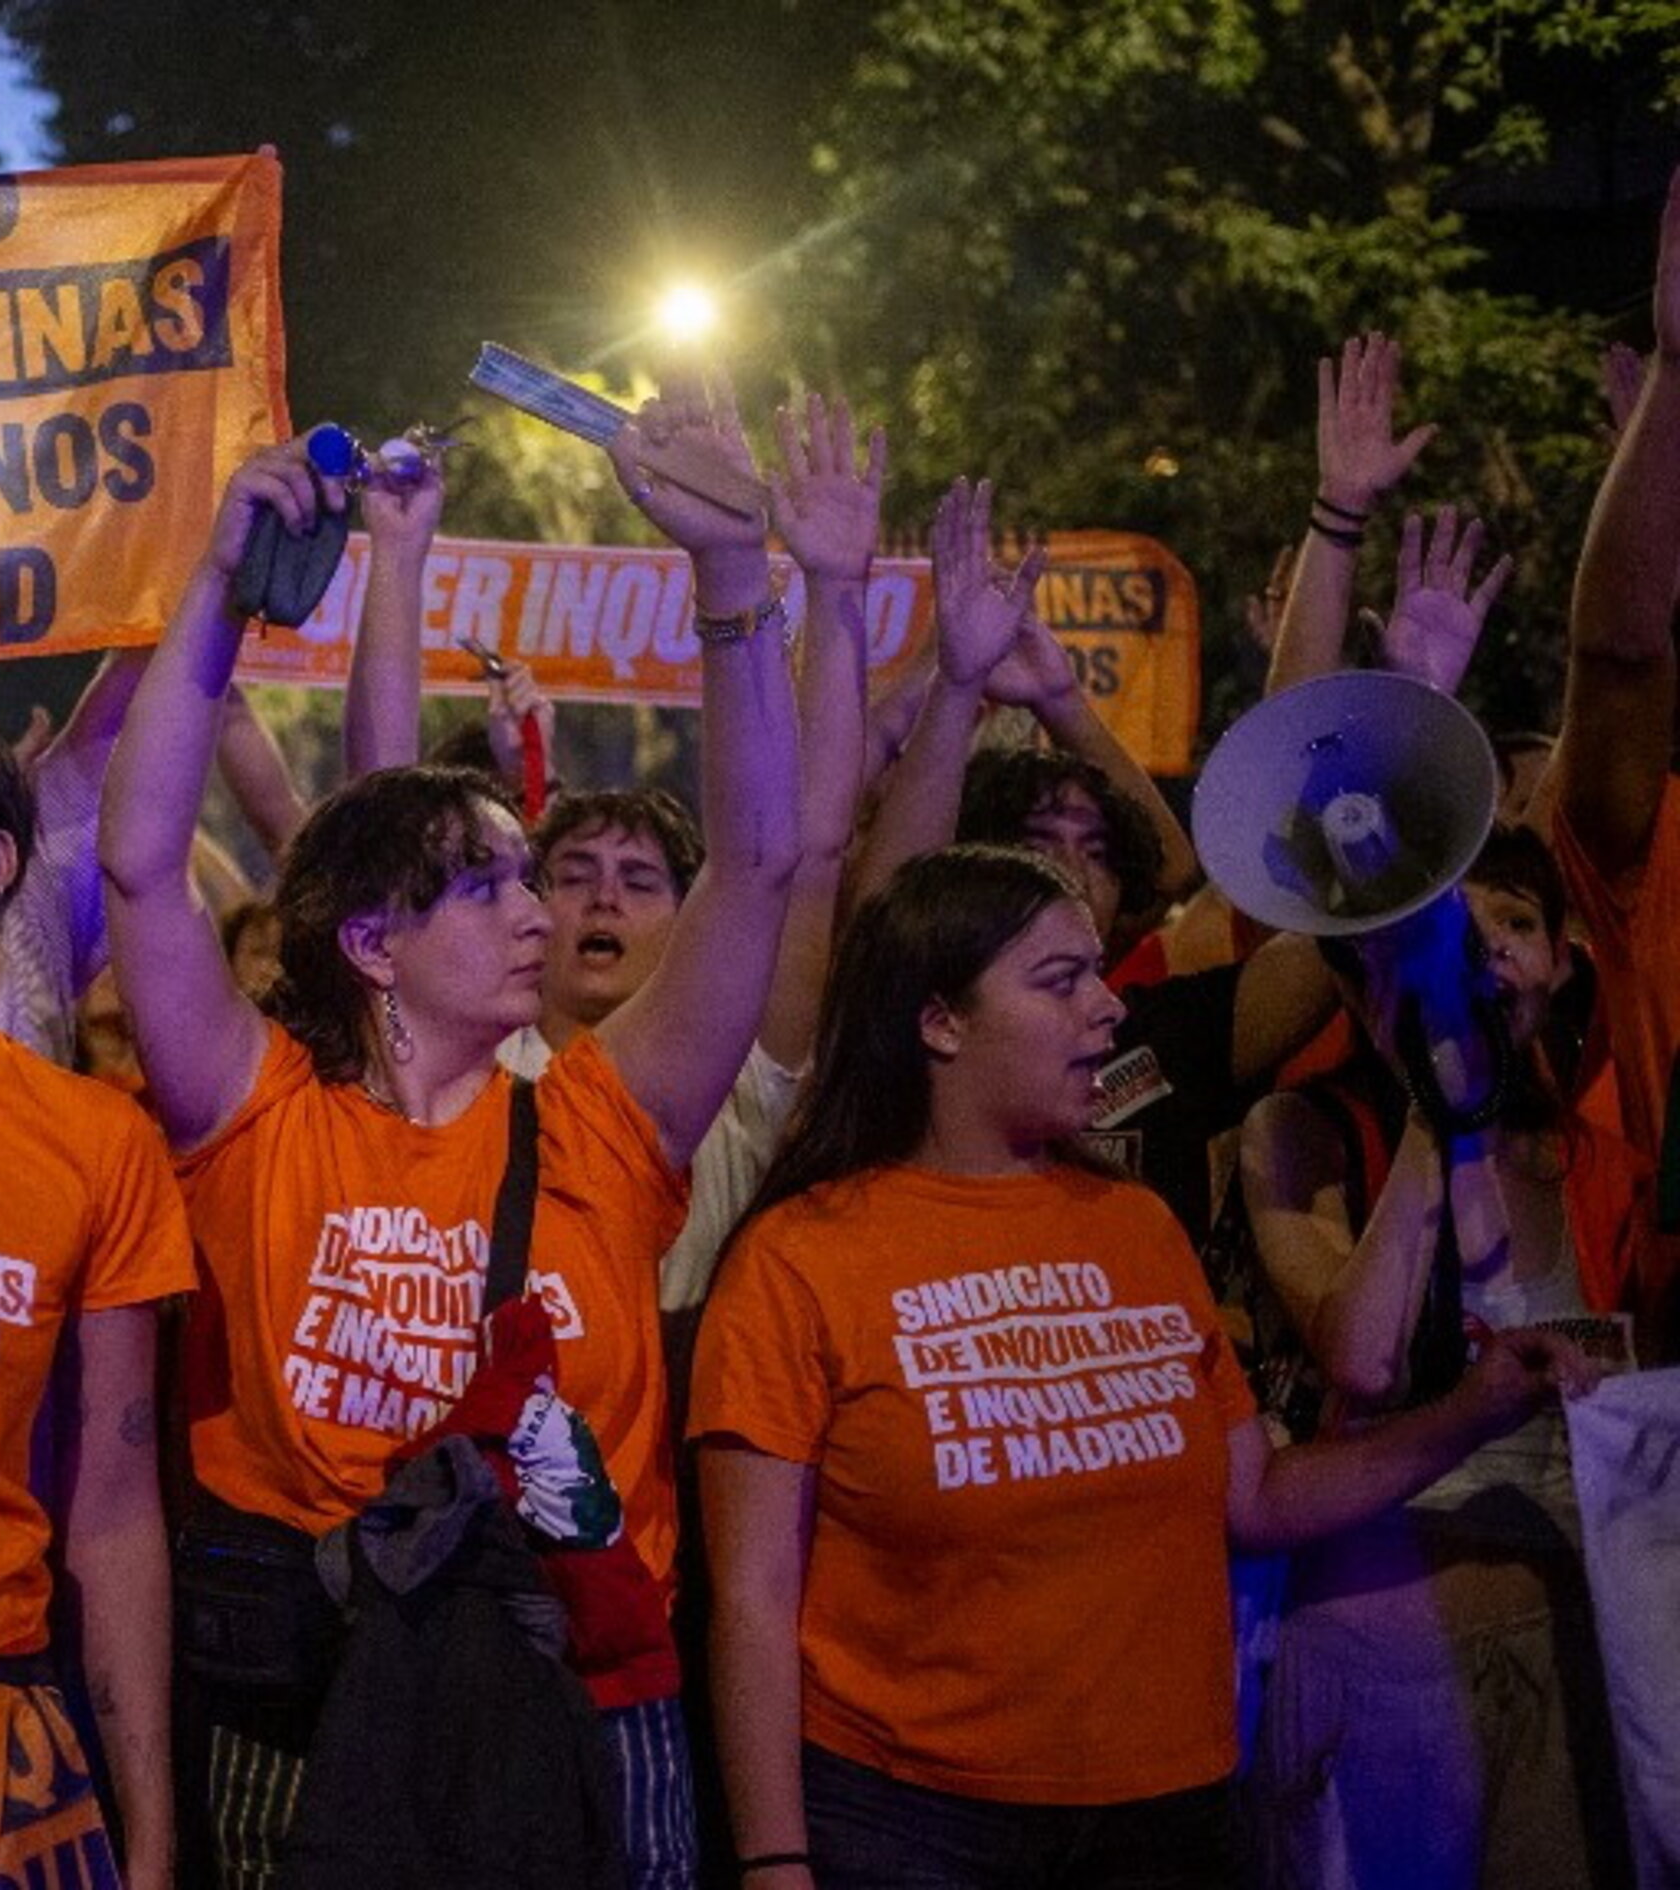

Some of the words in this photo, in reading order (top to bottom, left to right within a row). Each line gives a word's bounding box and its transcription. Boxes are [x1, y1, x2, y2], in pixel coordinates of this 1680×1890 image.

[294, 1295, 332, 1348] E
[891, 1262, 1114, 1335] SINDICATO
[911, 1339, 972, 1374] DE
[972, 1312, 1197, 1372] INQUILINAS
[925, 1390, 956, 1436] E
[960, 1361, 1197, 1431] INQUILINOS
[934, 1437, 999, 1491] DE
[1004, 1412, 1186, 1481] MADRID
